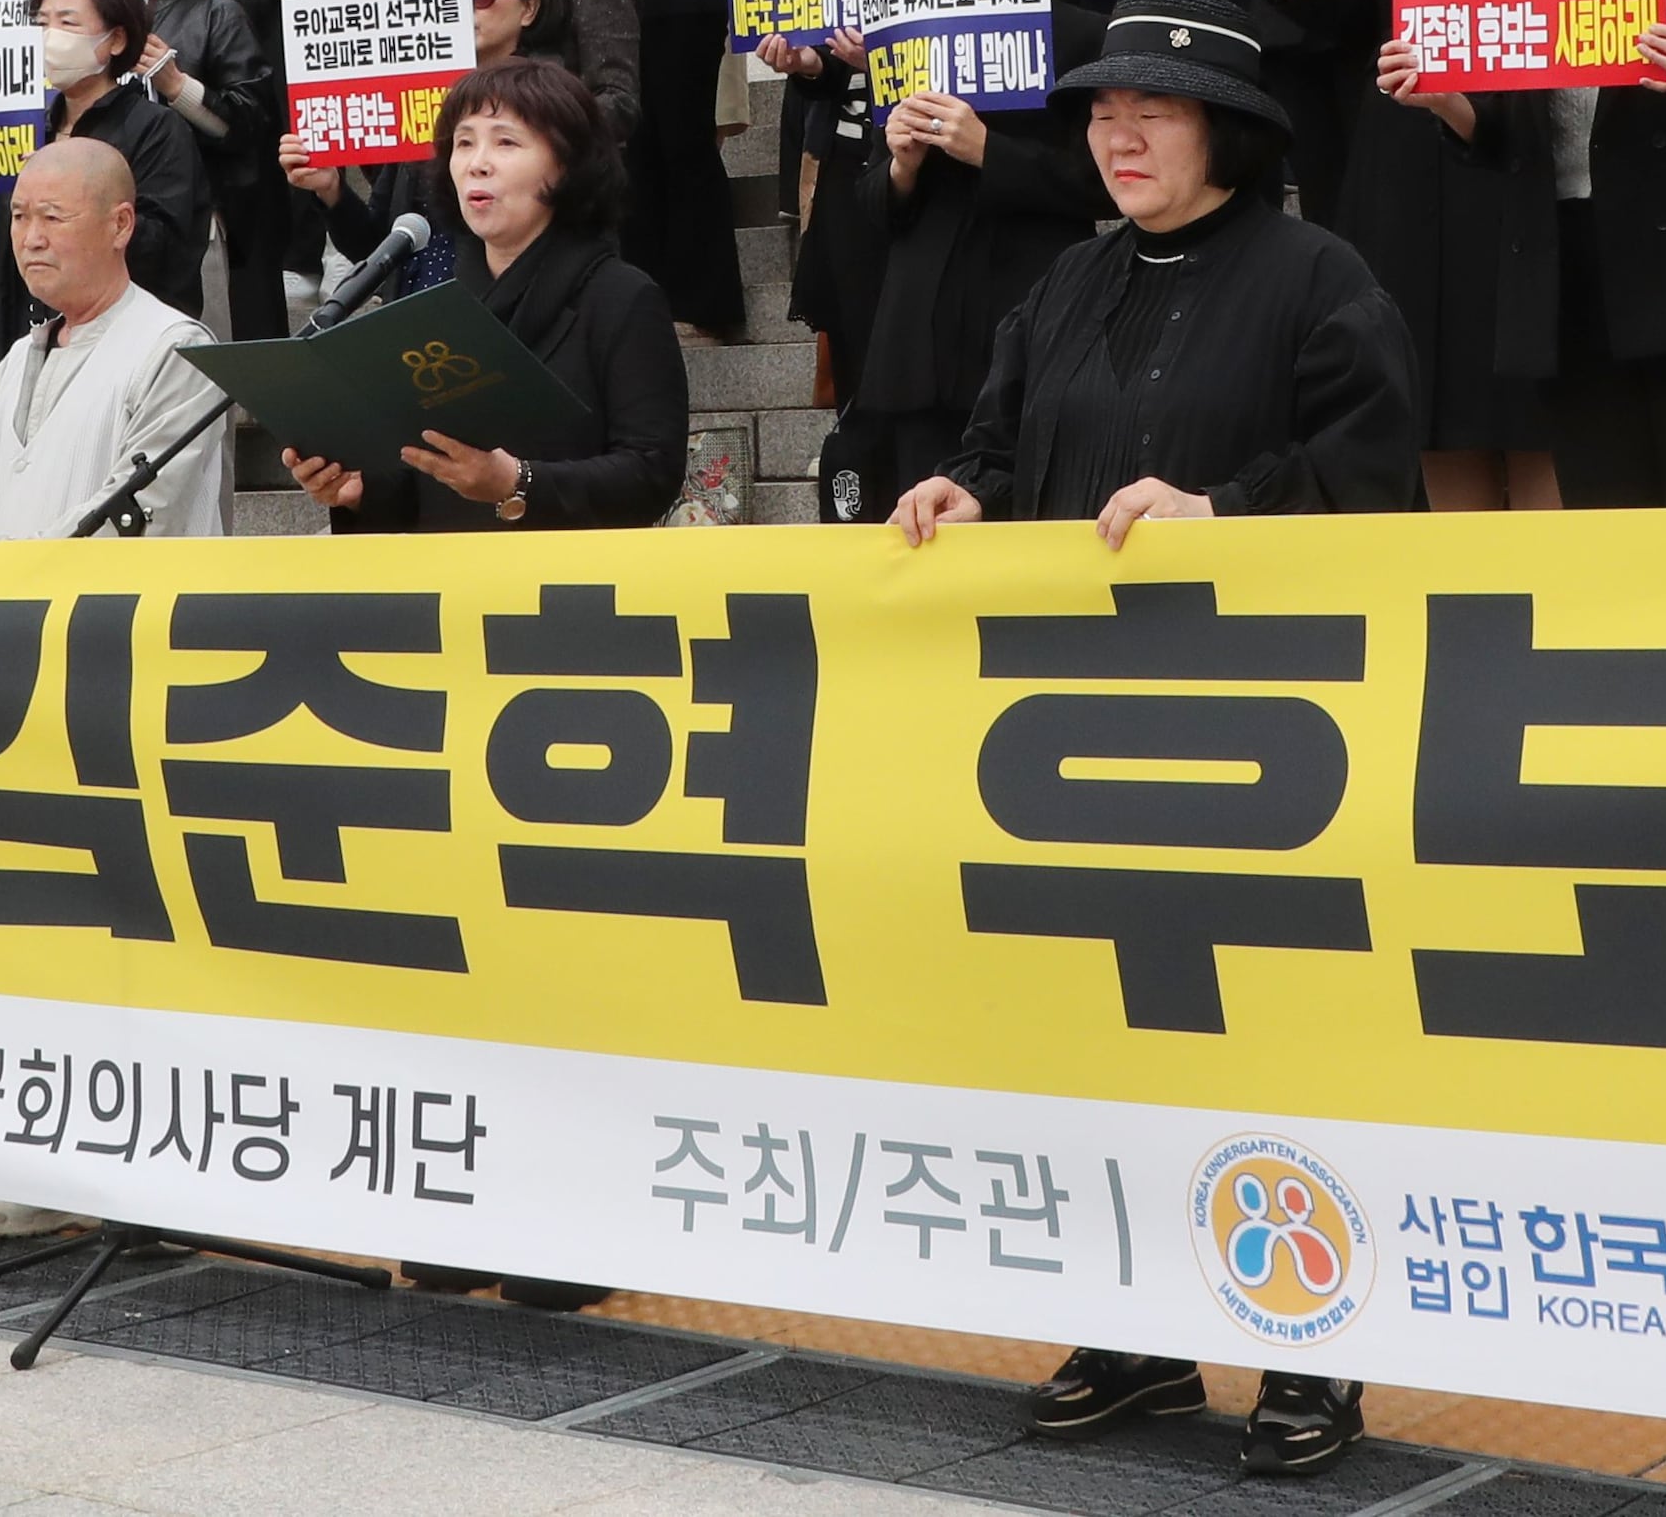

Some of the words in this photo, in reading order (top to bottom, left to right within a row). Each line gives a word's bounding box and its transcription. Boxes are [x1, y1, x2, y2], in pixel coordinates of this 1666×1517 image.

[293, 2, 380, 37] 유아교육의
[304, 39, 373, 71] 친일파로
[380, 32, 453, 64] 매도하는
[295, 93, 345, 152] 김준혁
[346, 91, 398, 149] 후보는
[331, 1083, 486, 1205] 계단
[651, 1115, 1070, 1274] 주최/주관
[1194, 1182, 1210, 1227] KOREA
[1204, 1139, 1296, 1181] KINDERGARTEN
[1299, 1156, 1366, 1244] ASSOCIATION
[1399, 1194, 1503, 1251] 사단
[1405, 1256, 1510, 1320] 법인
[1537, 1294, 1664, 1339] KOREA
